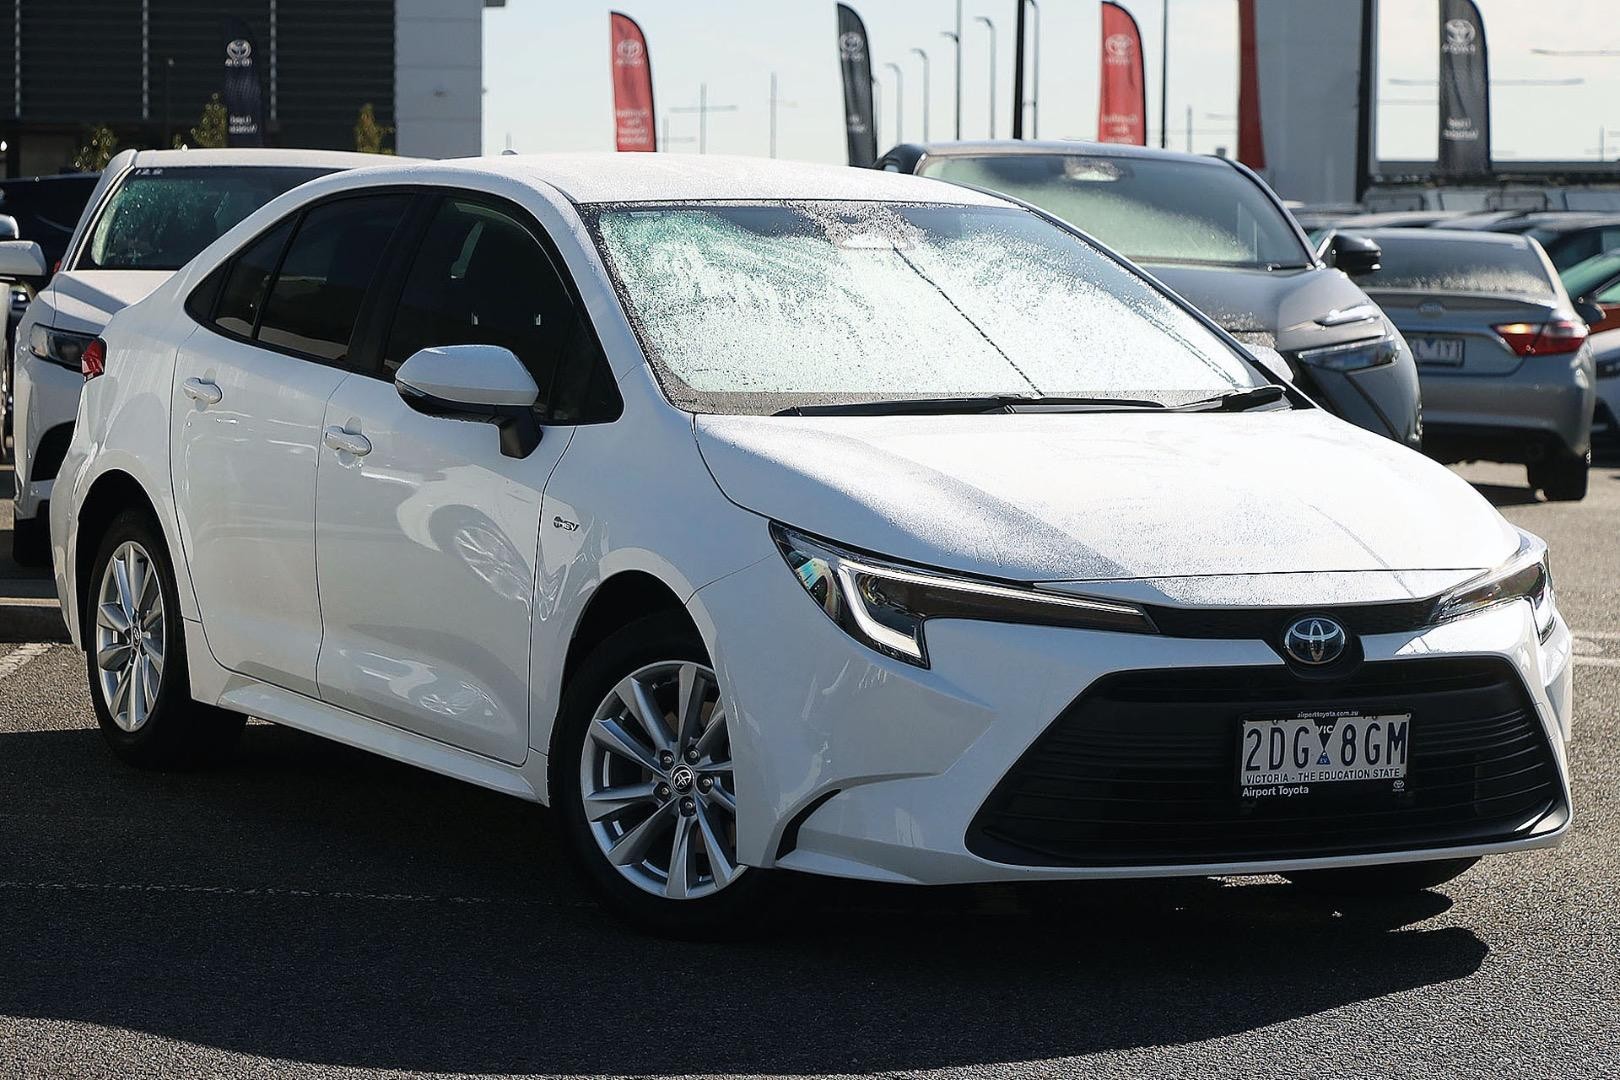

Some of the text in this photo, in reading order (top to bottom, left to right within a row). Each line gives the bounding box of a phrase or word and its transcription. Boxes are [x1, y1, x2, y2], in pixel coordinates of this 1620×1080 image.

[1245, 722, 1407, 771] 2DG 8GM
[1246, 773, 1289, 784] VICTORIA
[1298, 771, 1316, 781] THE
[1318, 769, 1370, 780] EDUCATION
[1373, 768, 1400, 778] STATE
[1242, 786, 1310, 798] Airport Toyota
